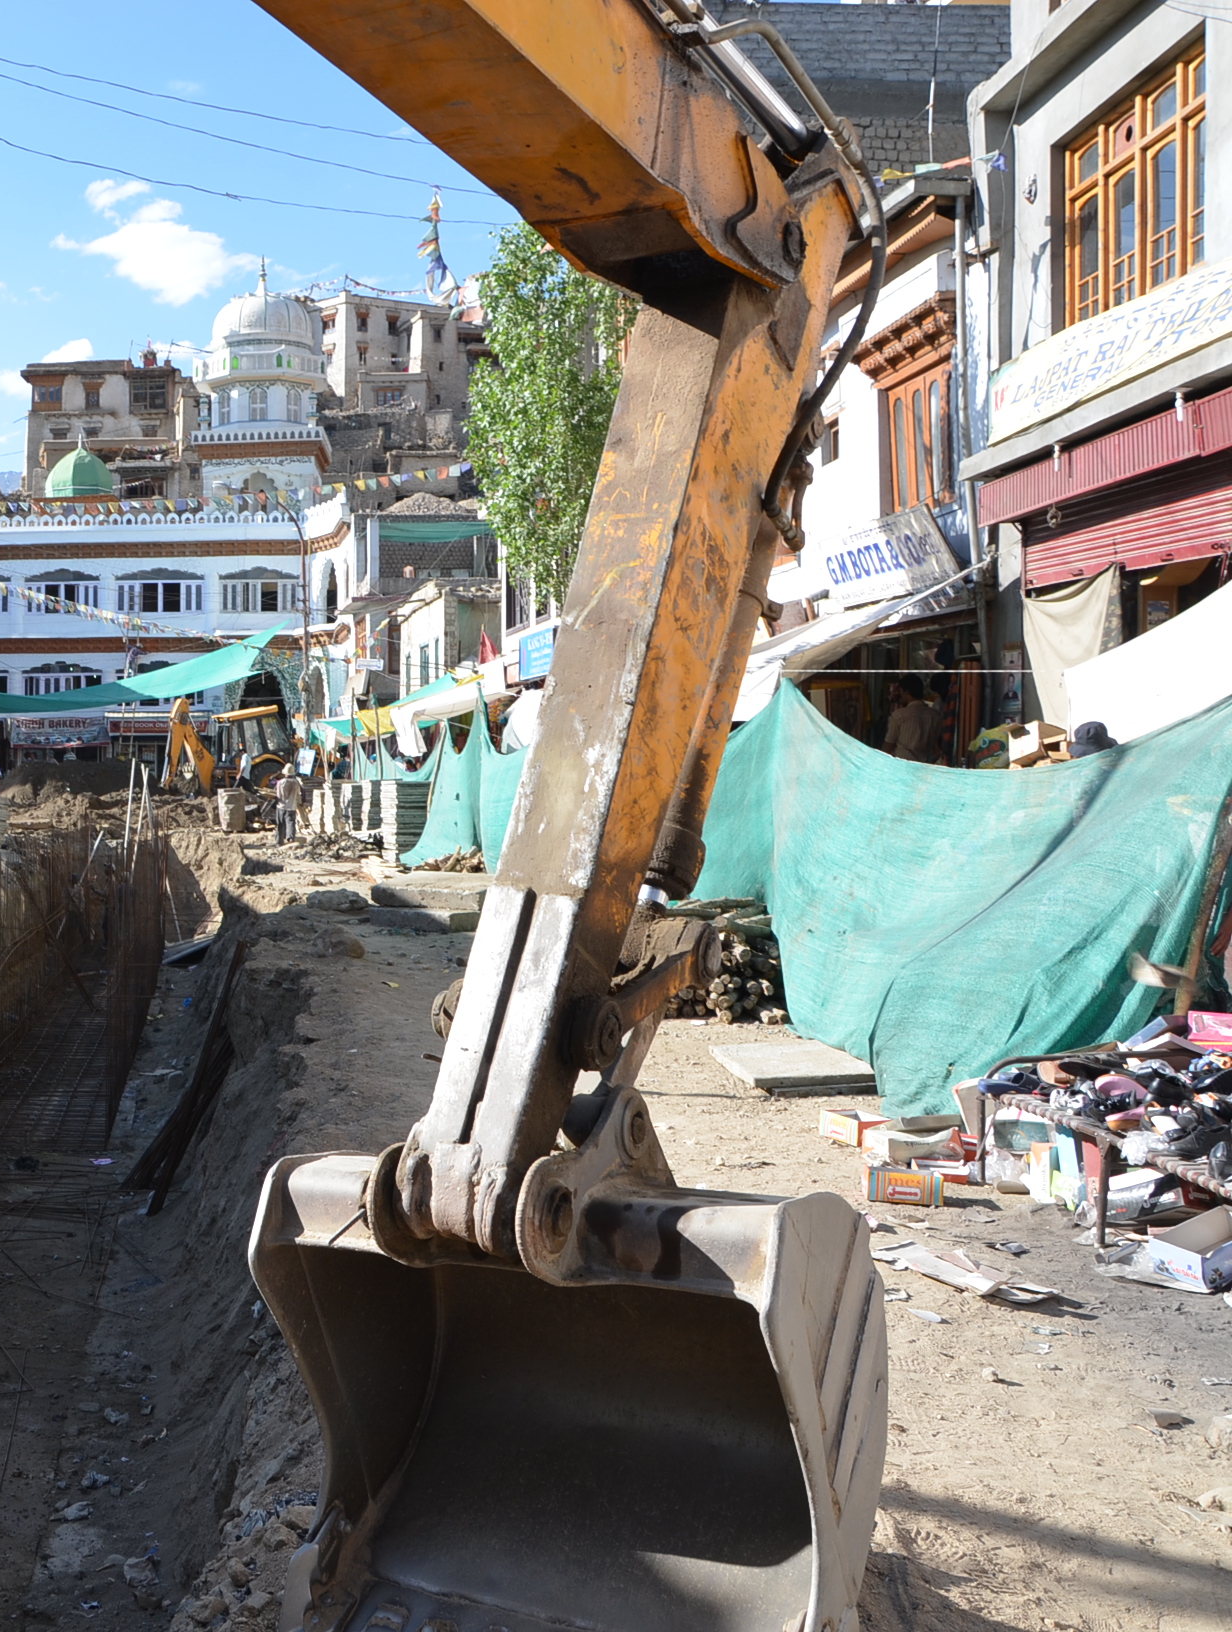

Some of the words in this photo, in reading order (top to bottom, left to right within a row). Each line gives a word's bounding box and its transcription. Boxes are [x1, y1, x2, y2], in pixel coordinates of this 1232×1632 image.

[1010, 350, 1089, 405] LAJPAT
[1091, 327, 1140, 365] RAI
[1143, 287, 1232, 341] TRILO
[1033, 356, 1126, 408] GENERAL
[885, 538, 906, 570] &
[48, 719, 88, 729] BAKERY
